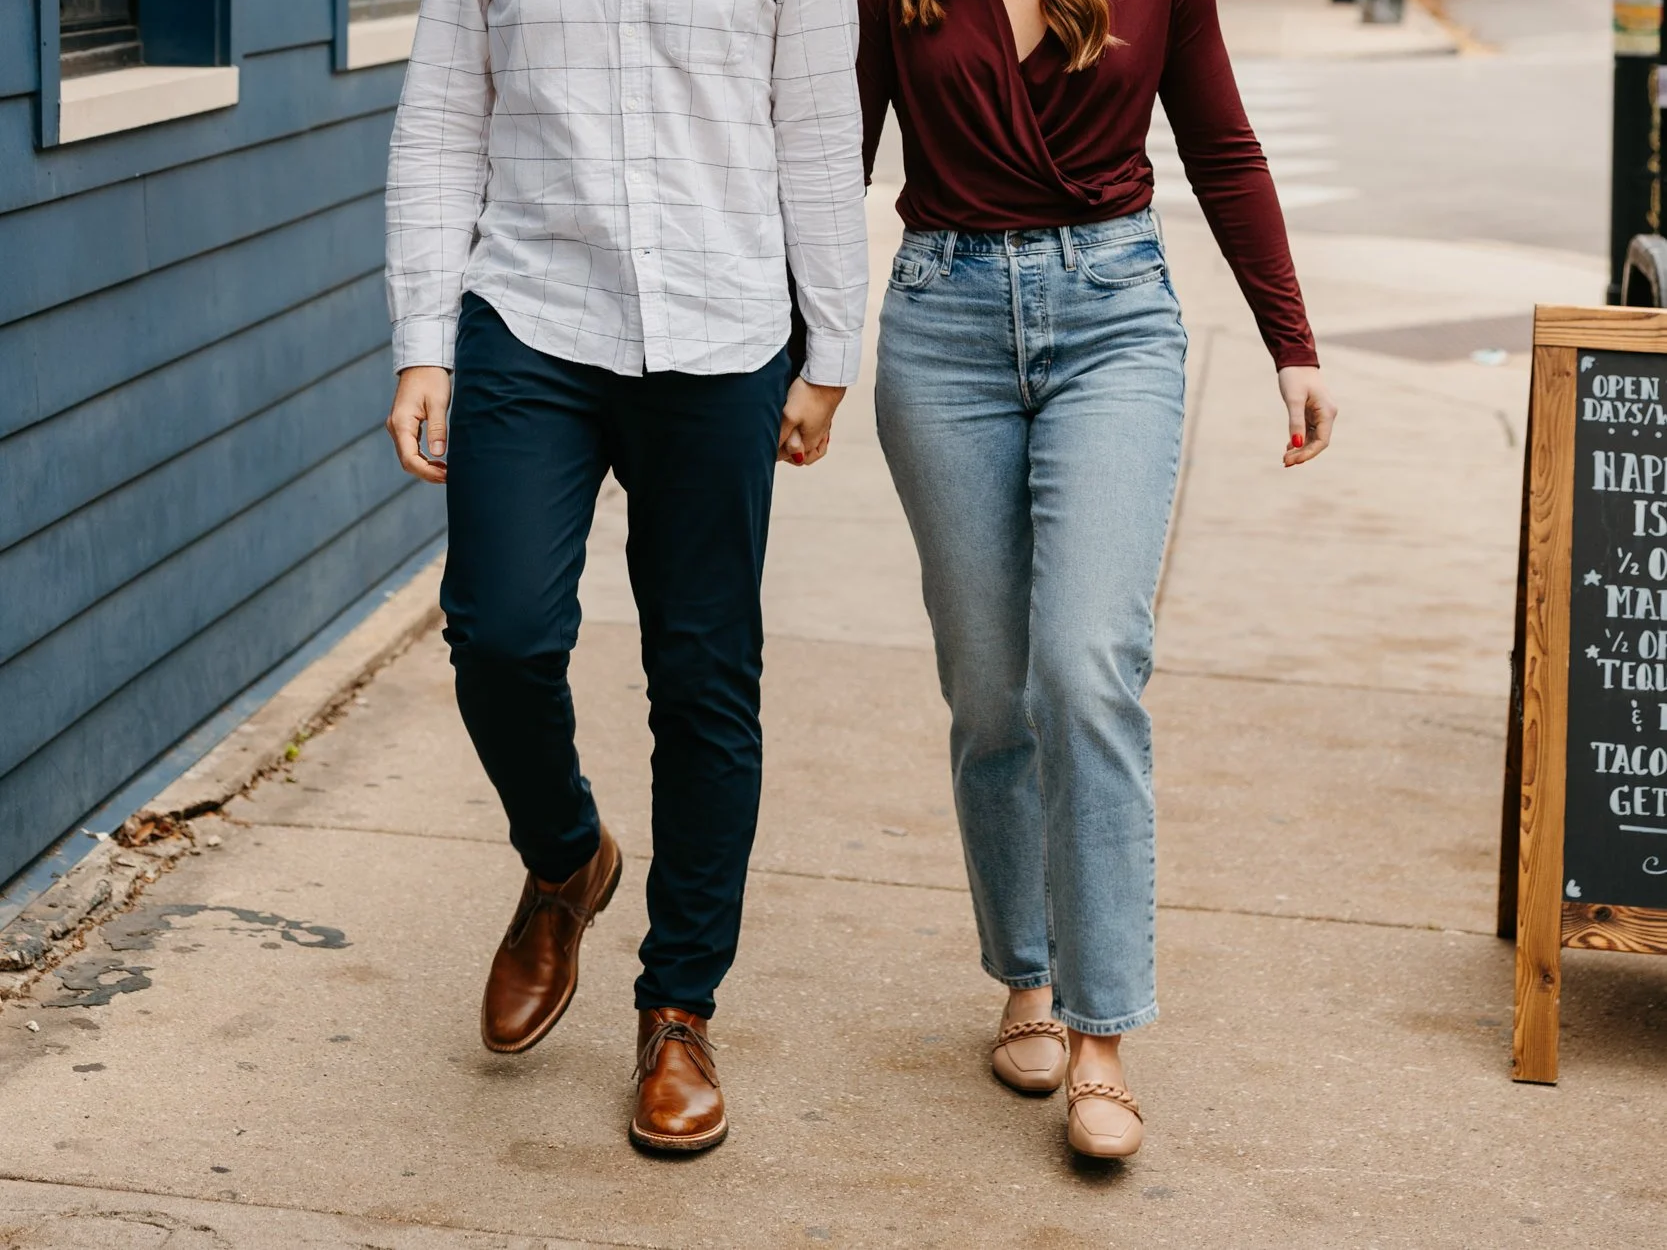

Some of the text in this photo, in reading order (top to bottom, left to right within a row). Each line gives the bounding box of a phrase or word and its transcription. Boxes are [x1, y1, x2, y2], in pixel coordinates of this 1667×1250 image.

[1592, 375, 1660, 400] OPEN
[1592, 450, 1667, 495] HAP
[1590, 741, 1667, 777] TACO
[1609, 784, 1667, 817] GET
